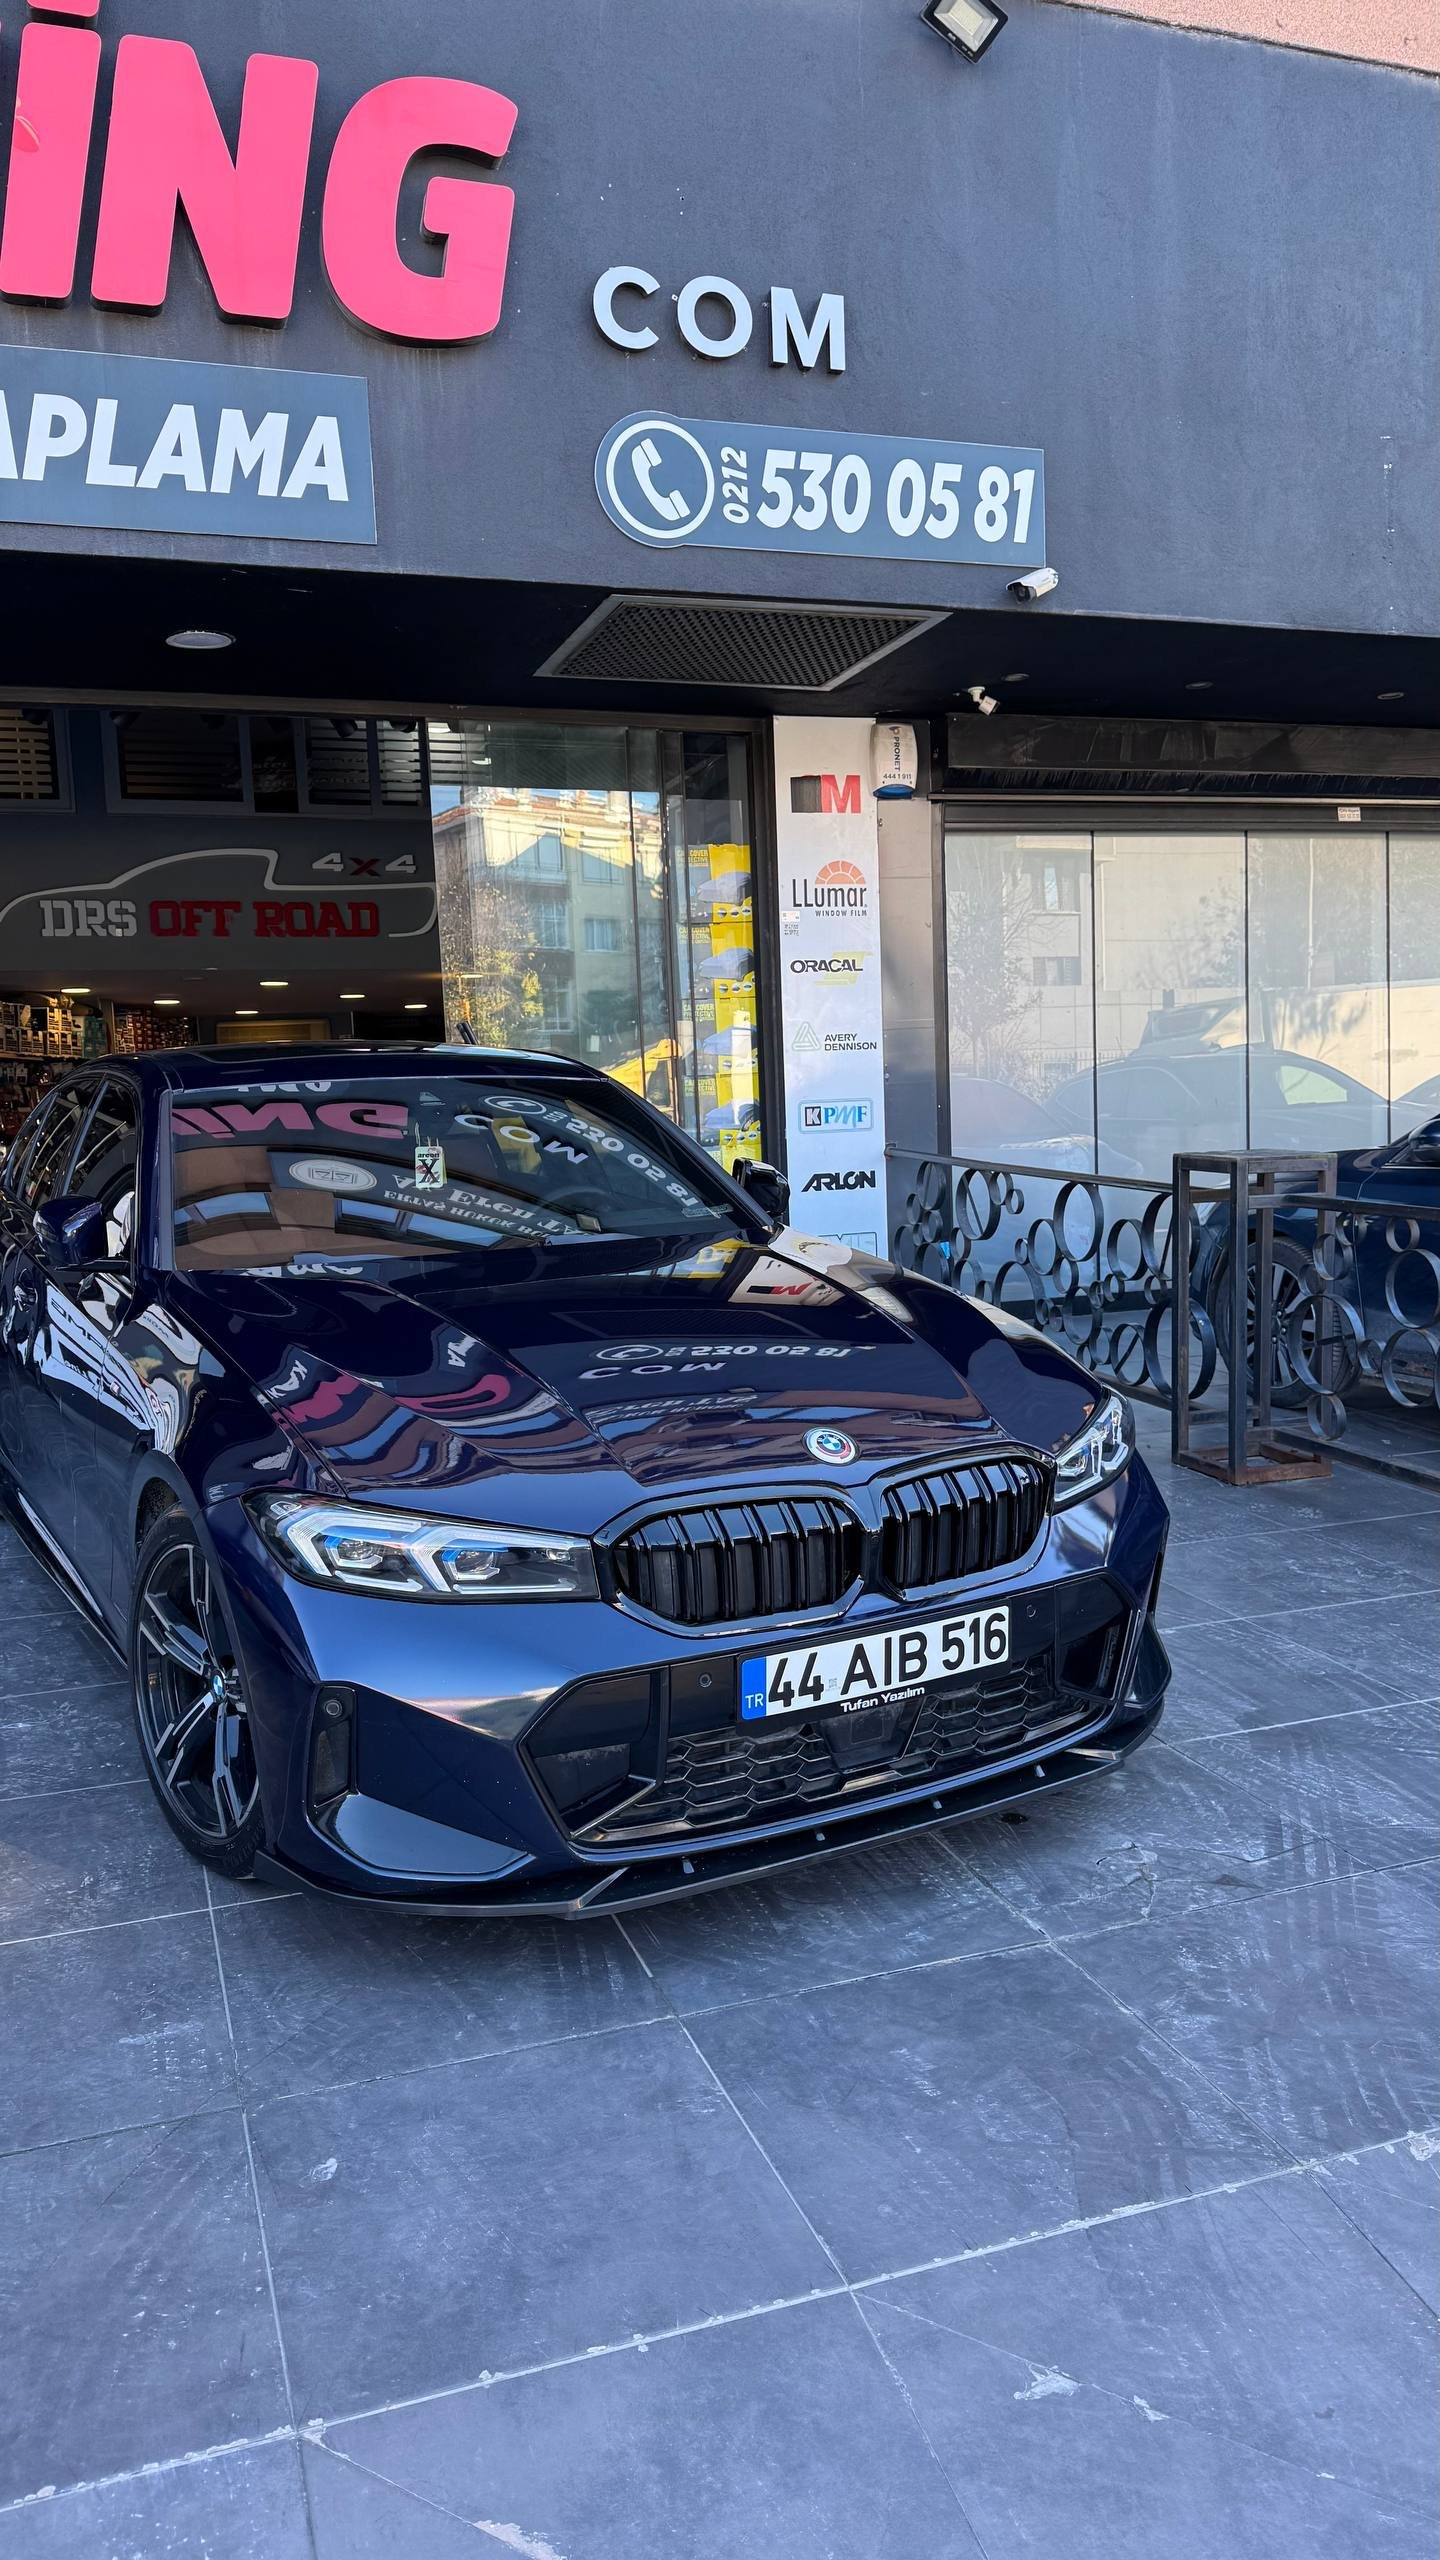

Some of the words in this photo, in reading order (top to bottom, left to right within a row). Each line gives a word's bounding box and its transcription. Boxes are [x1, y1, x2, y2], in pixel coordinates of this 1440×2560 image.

[0, 0, 518, 340] İNG
[592, 265, 846, 373] COM
[0, 388, 349, 501] PLAMA
[721, 447, 747, 524] 0212
[756, 448, 872, 534] 530
[887, 458, 963, 540] 05
[973, 466, 1035, 544] 81
[893, 736, 901, 773] PRONET
[39, 900, 138, 938] DRS
[149, 900, 242, 938] OFF
[252, 901, 381, 938] ROAD
[850, 909, 868, 917] FILM
[790, 959, 864, 974] ORACAL
[824, 1033, 857, 1042] AVERY
[824, 1042, 877, 1051] DENNISON
[805, 1105, 868, 1128] KPMF
[801, 1170, 876, 1192] ARLON
[745, 1693, 764, 1709] TR
[768, 1651, 825, 1708] 44
[840, 1631, 928, 1696] AIB
[942, 1612, 1007, 1671] 516
[840, 1698, 879, 1713] Tufan
[880, 1686, 925, 1703] Yazılım
